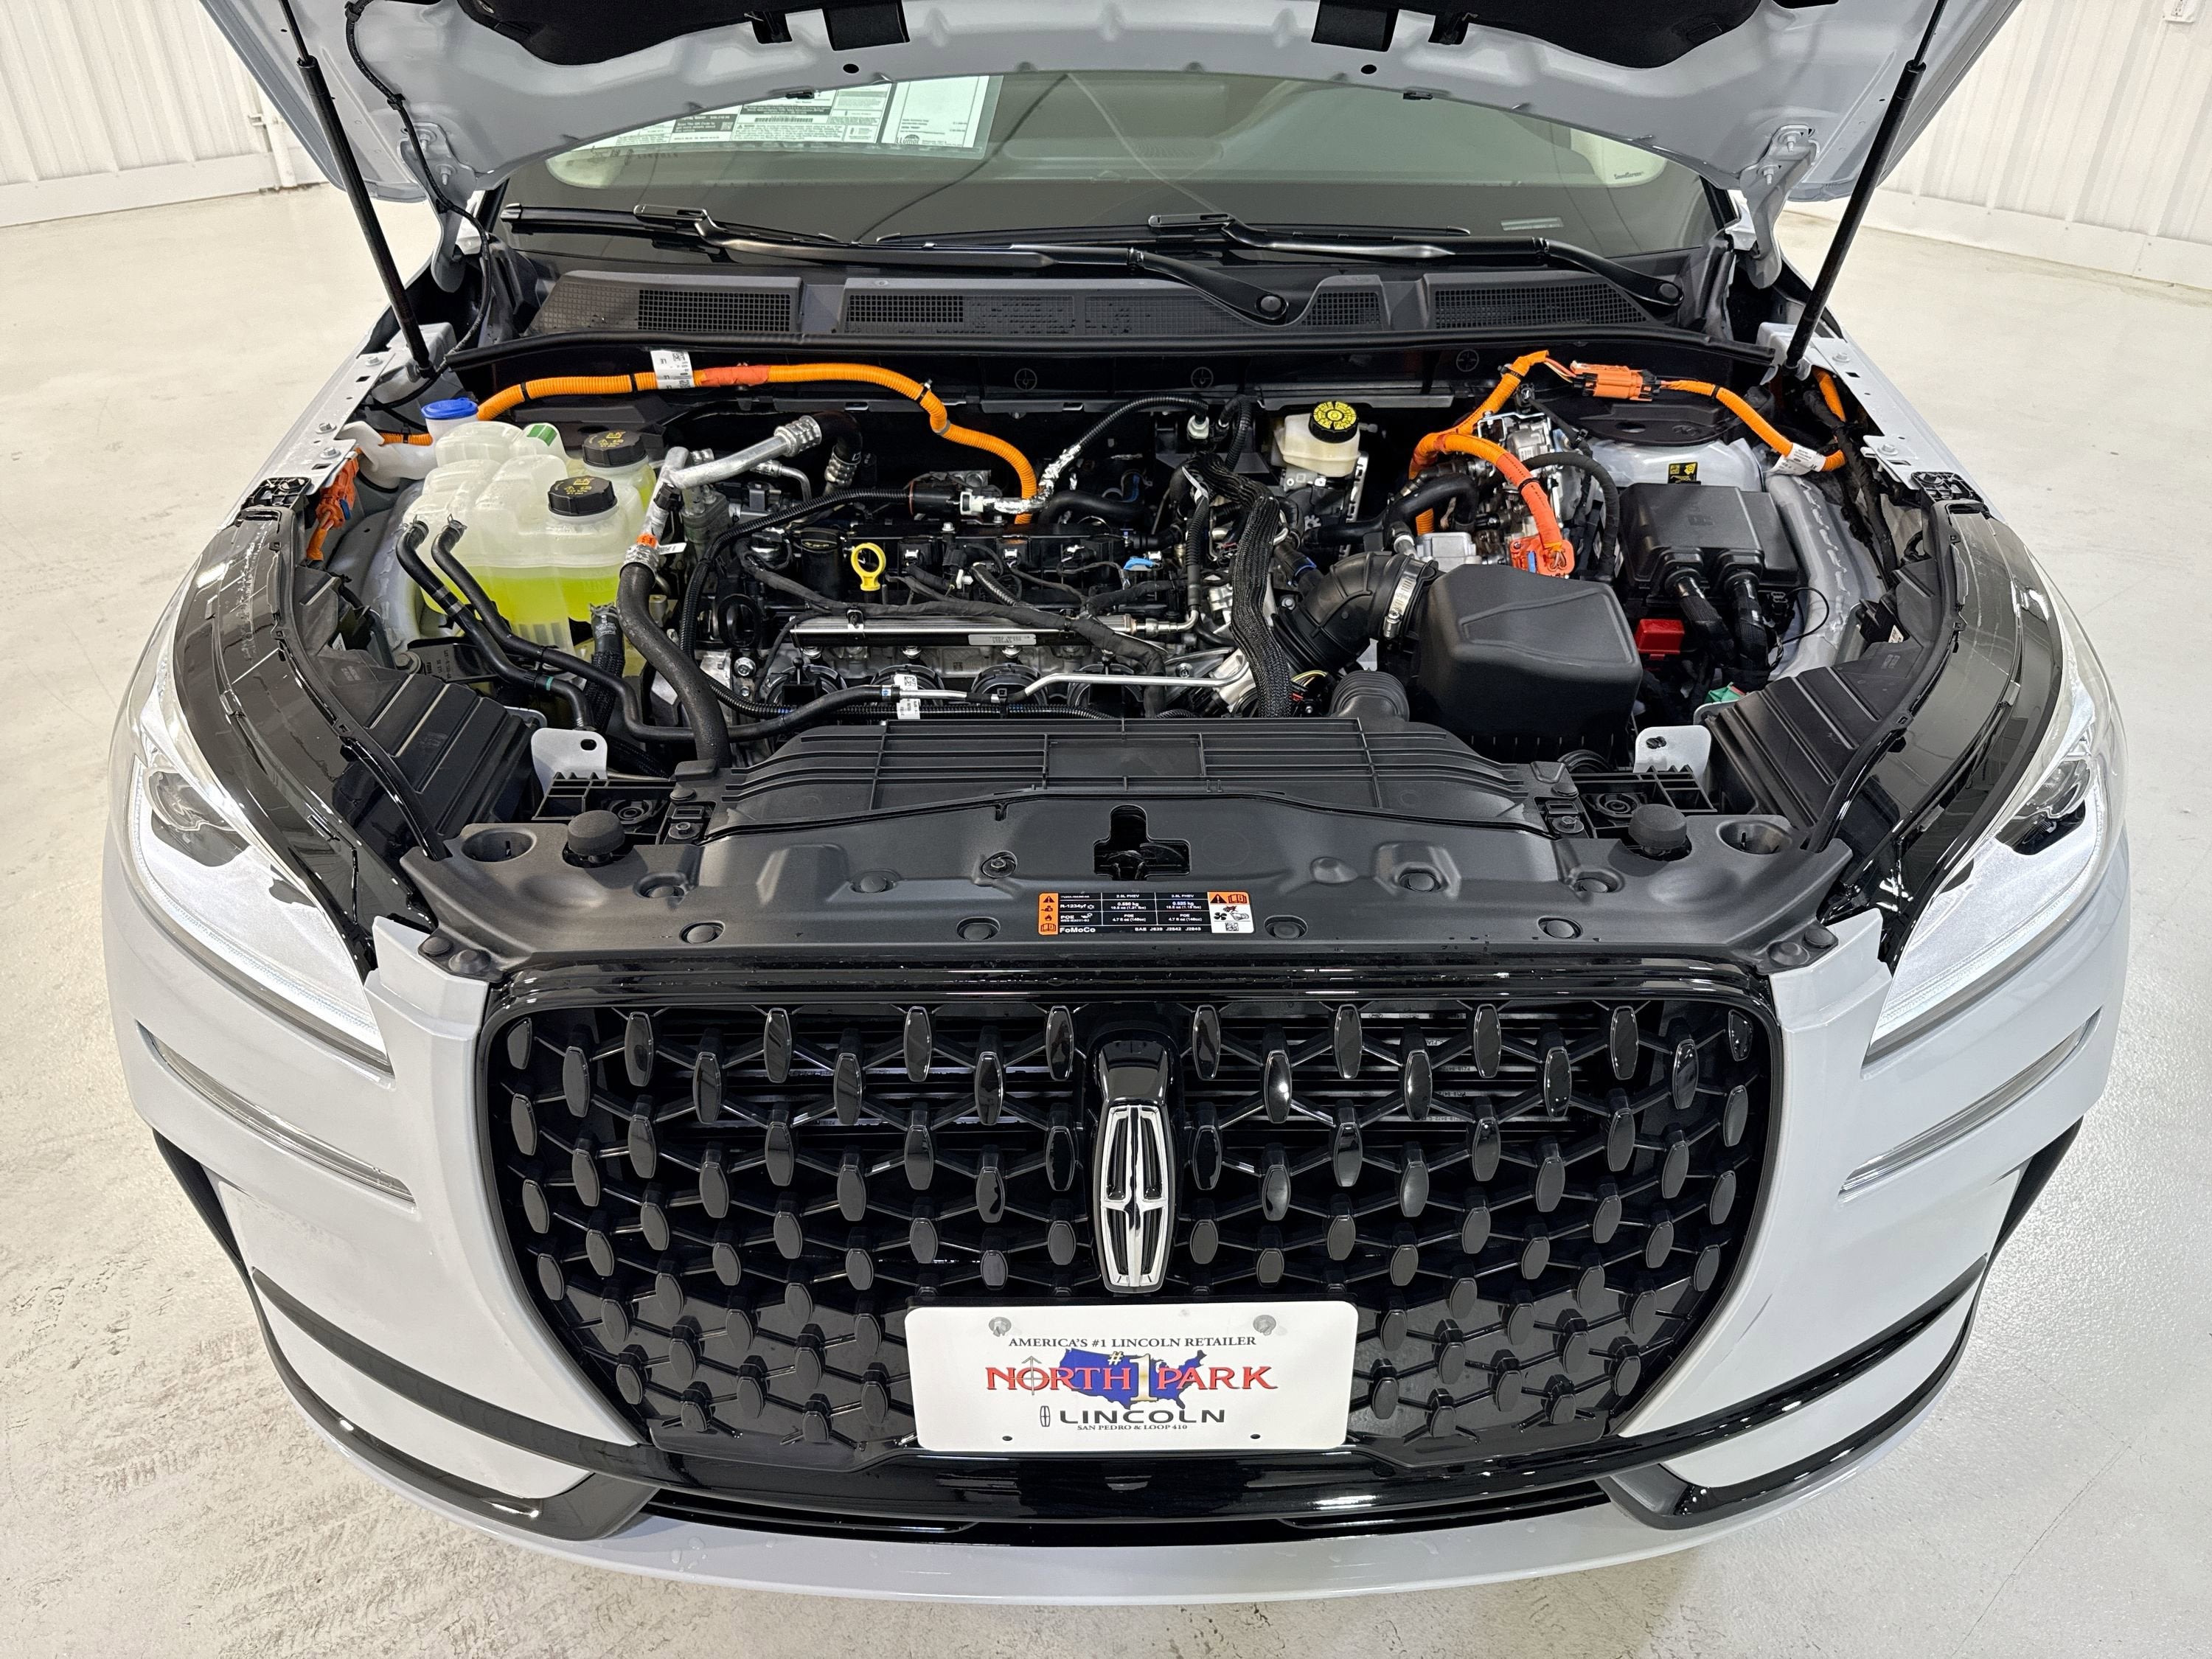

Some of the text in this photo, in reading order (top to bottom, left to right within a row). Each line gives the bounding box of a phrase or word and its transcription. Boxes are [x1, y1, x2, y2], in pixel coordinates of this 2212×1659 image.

[1009, 1336, 1256, 1347] AMERICA'S #1 LINCOLN RETAILER
[985, 1366, 1279, 1391] NORTH PARK
[1060, 1409, 1225, 1424] LINCOLN
